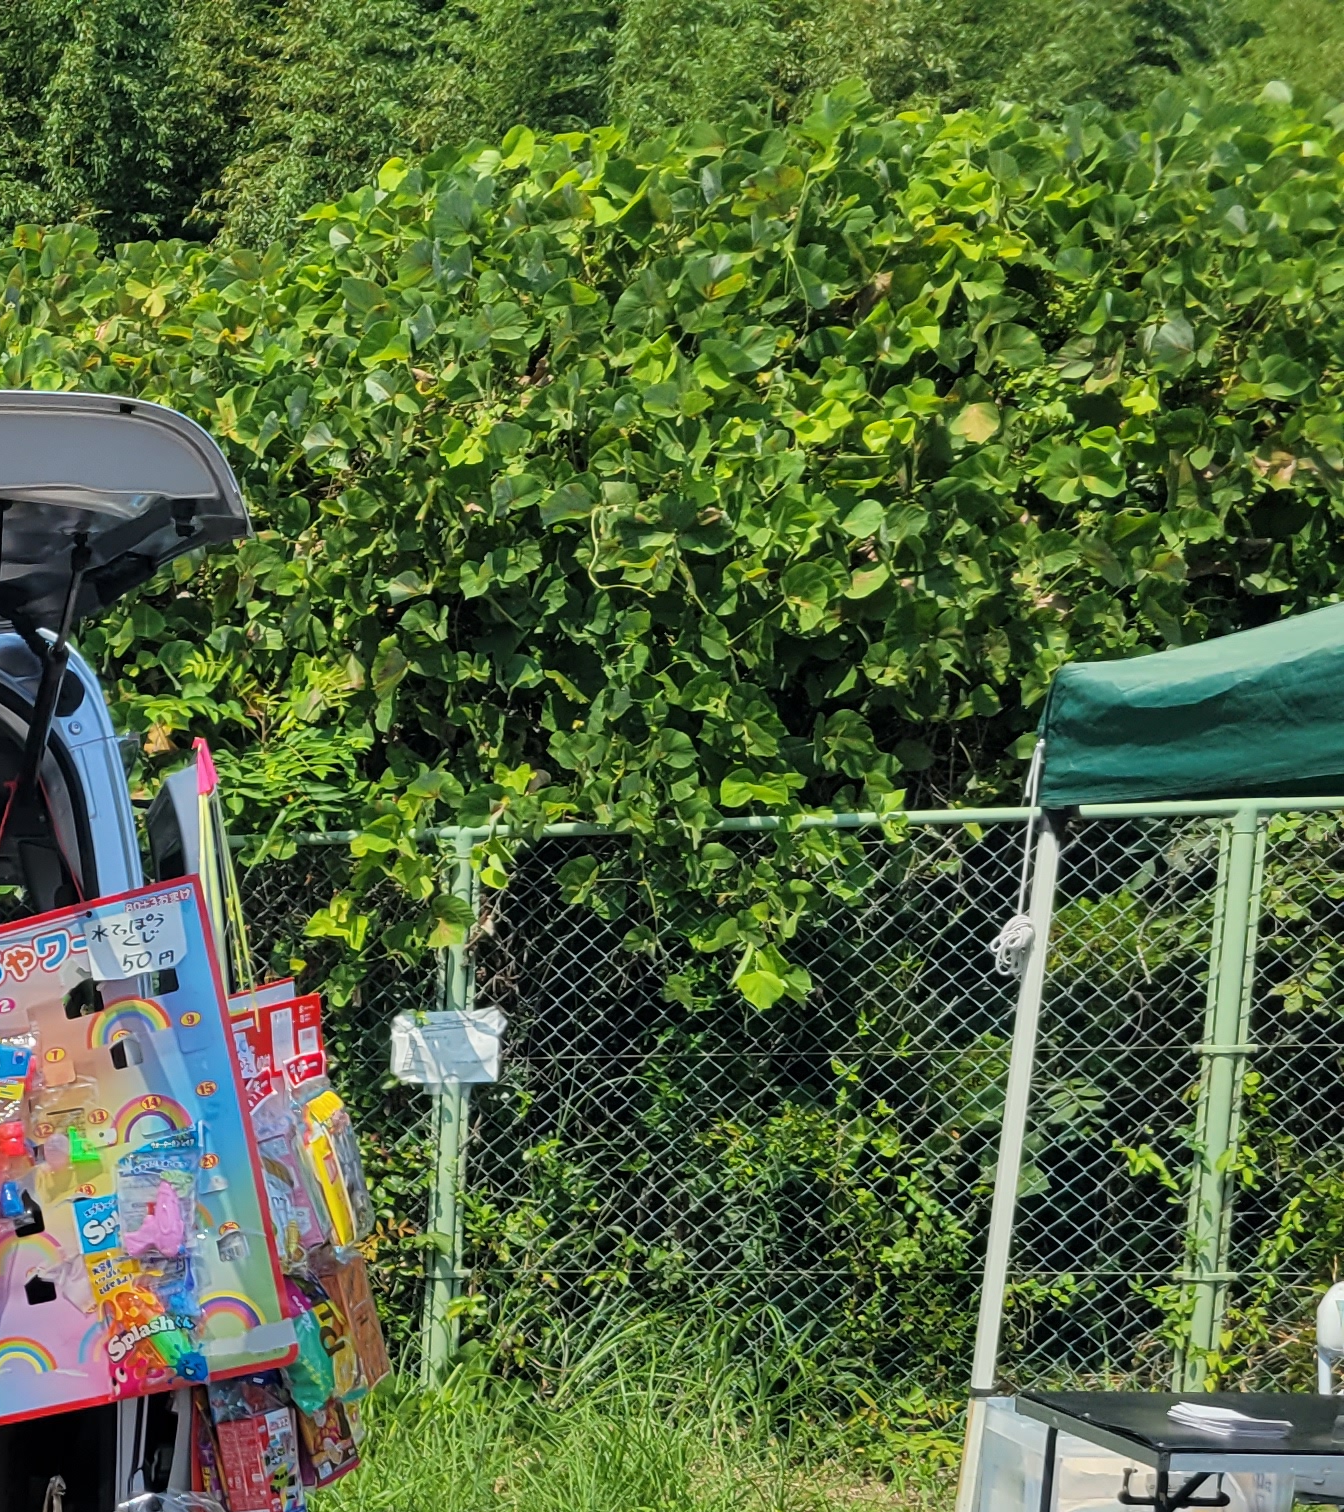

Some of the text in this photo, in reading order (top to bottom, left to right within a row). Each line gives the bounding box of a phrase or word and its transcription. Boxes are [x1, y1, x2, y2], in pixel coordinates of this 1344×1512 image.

[90, 912, 166, 943] 水てっぽう
[121, 929, 160, 947] くじ
[121, 950, 176, 973] 50円
[108, 1315, 176, 1362] Splash
